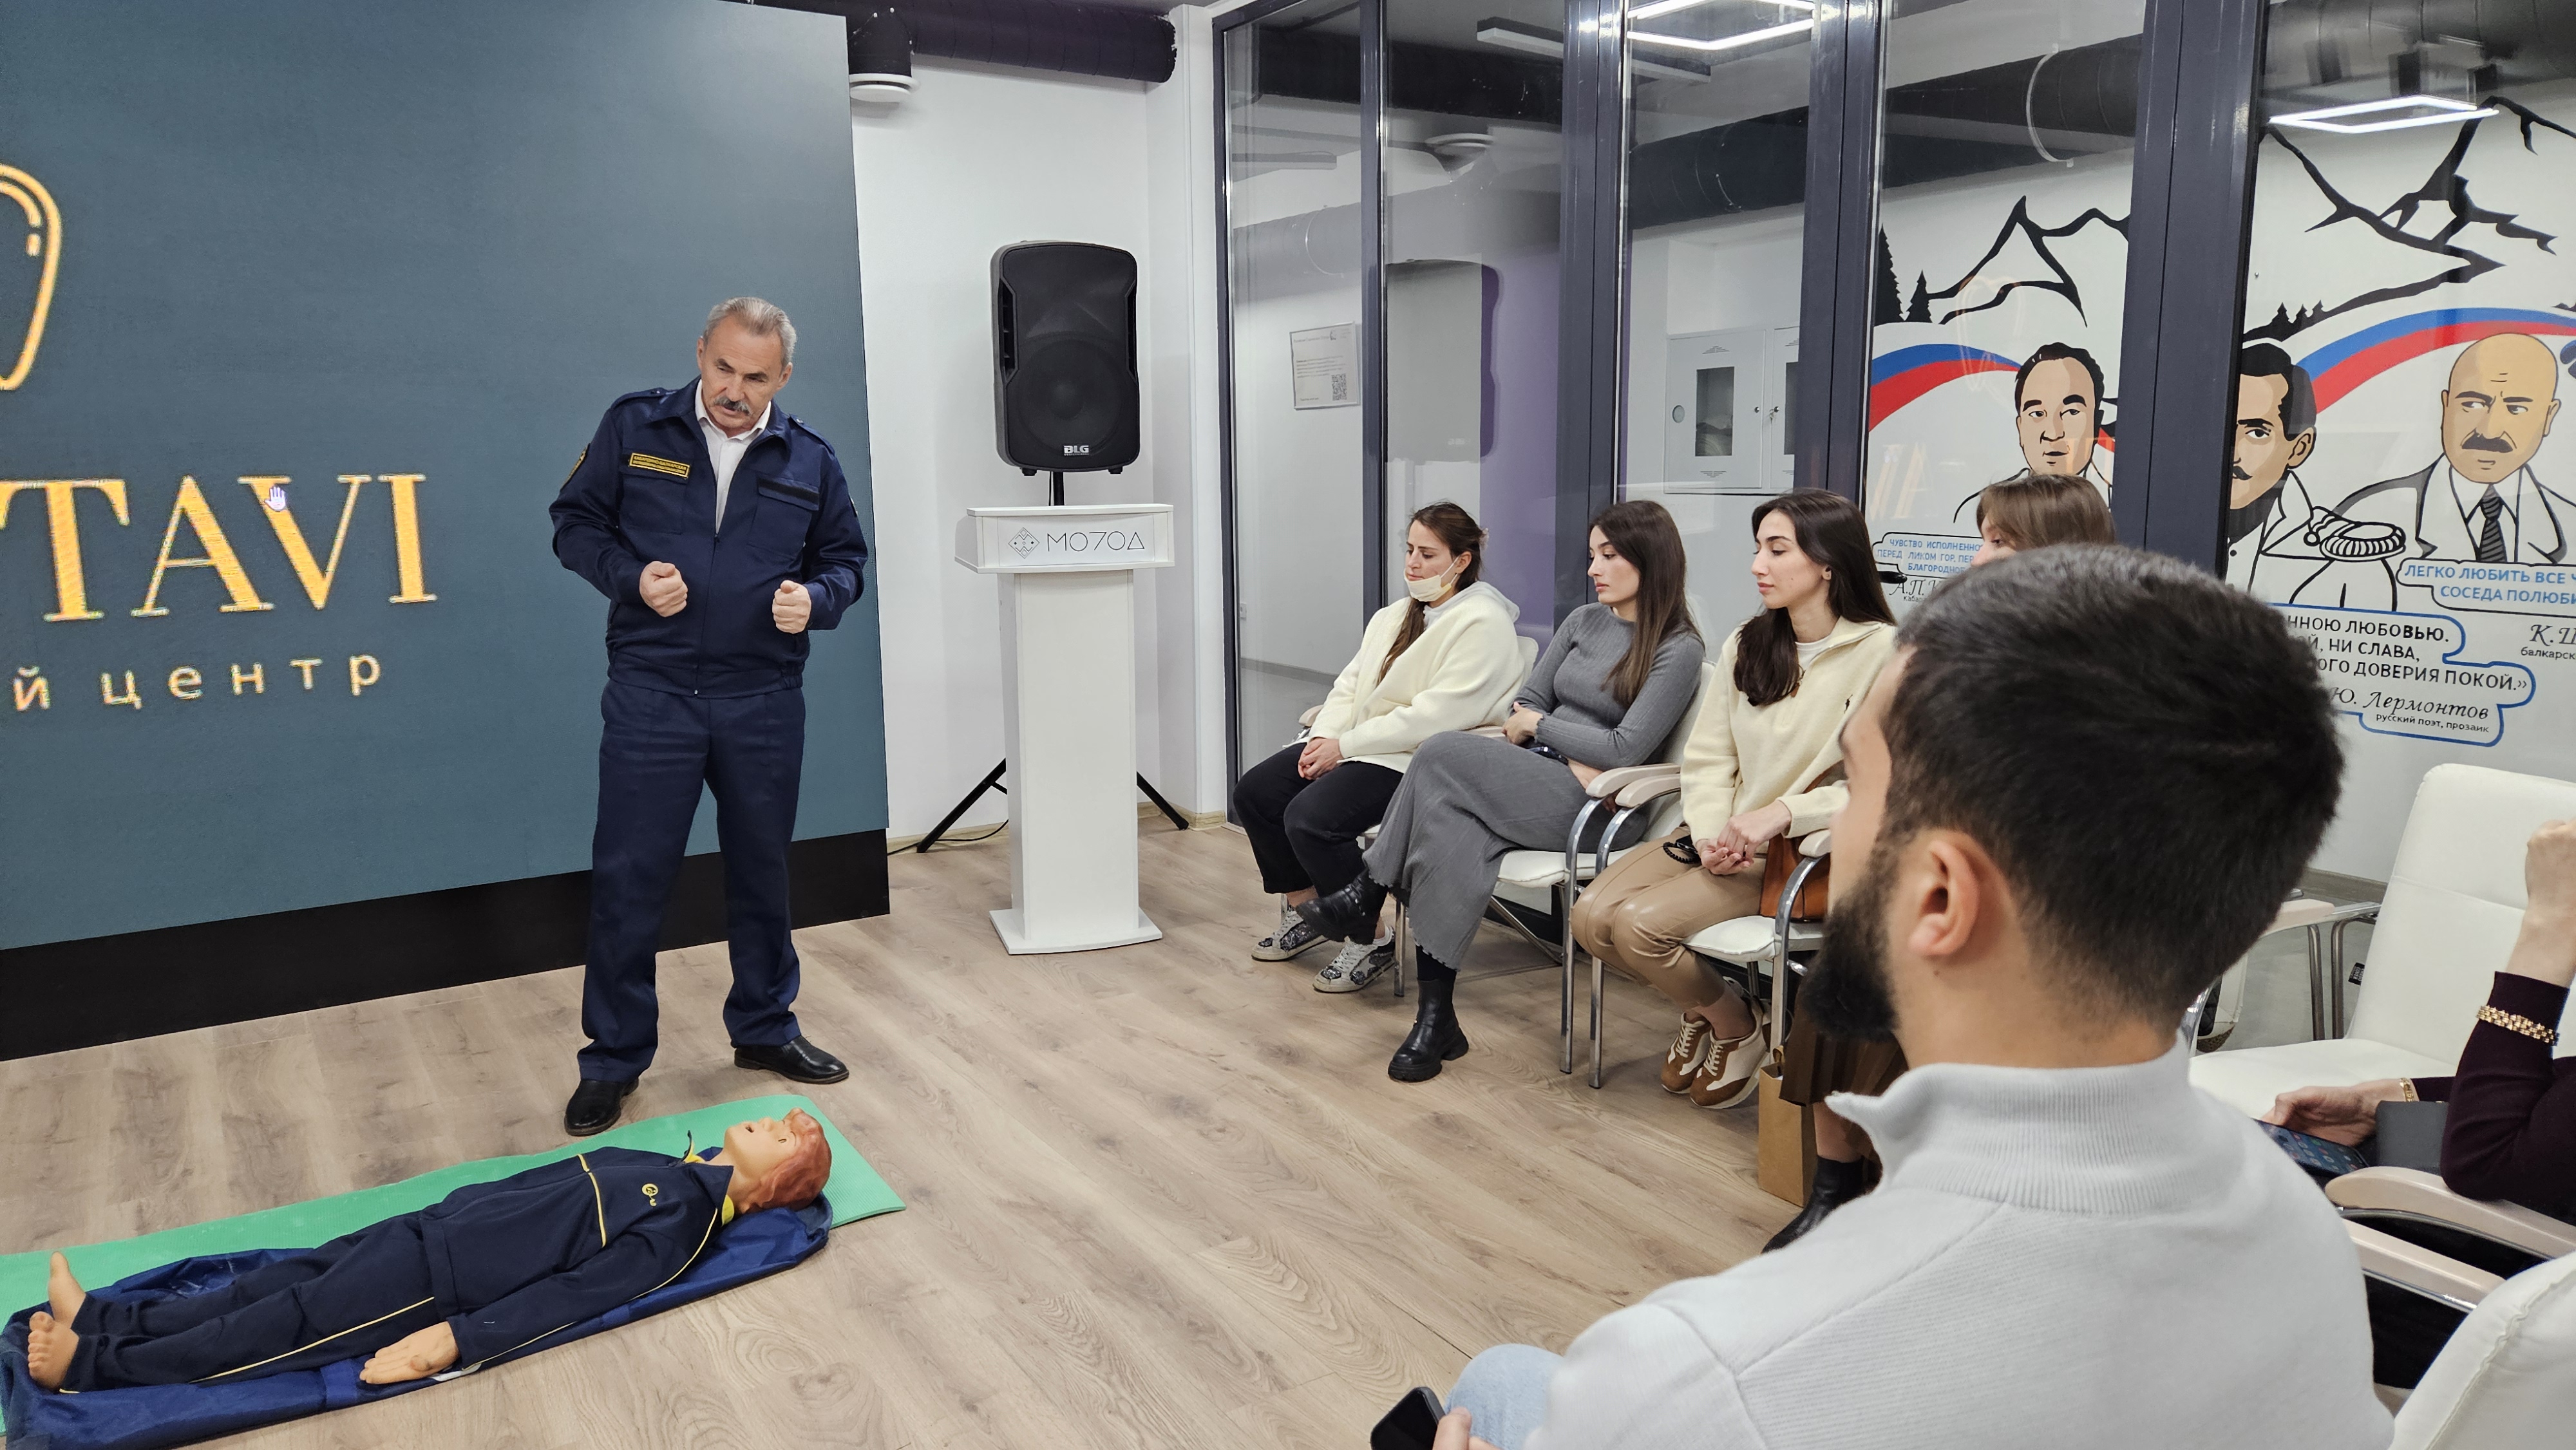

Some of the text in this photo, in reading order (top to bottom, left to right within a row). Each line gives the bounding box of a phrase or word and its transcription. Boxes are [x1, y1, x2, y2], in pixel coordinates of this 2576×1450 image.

[1064, 445, 1089, 453] BLG
[0, 475, 437, 622] TAVI
[1889, 539, 1923, 548] ЧУВСТВО
[1877, 549, 1902, 559] ПЕРЕД
[1908, 552, 1937, 561] ЛИКОМ
[1940, 554, 1956, 563] ГОР.
[2405, 565, 2456, 578] ЛЕГКО
[2459, 568, 2530, 583] ЛЮБИТЬ
[2535, 571, 2566, 584] ВСЕ
[2440, 586, 2502, 601] СОСЕДА
[2345, 621, 2449, 643] ЛЮБОВЬЮ.
[2329, 638, 2352, 653] НИ
[2358, 642, 2420, 663] СЛАВА,
[2521, 646, 2576, 661] балкарск
[100, 654, 381, 710] центр
[2353, 661, 2439, 683] ДОВЕРИЯ
[2363, 692, 2489, 719] Лермонтов
[2376, 713, 2489, 733] русский поэт, прозаик
